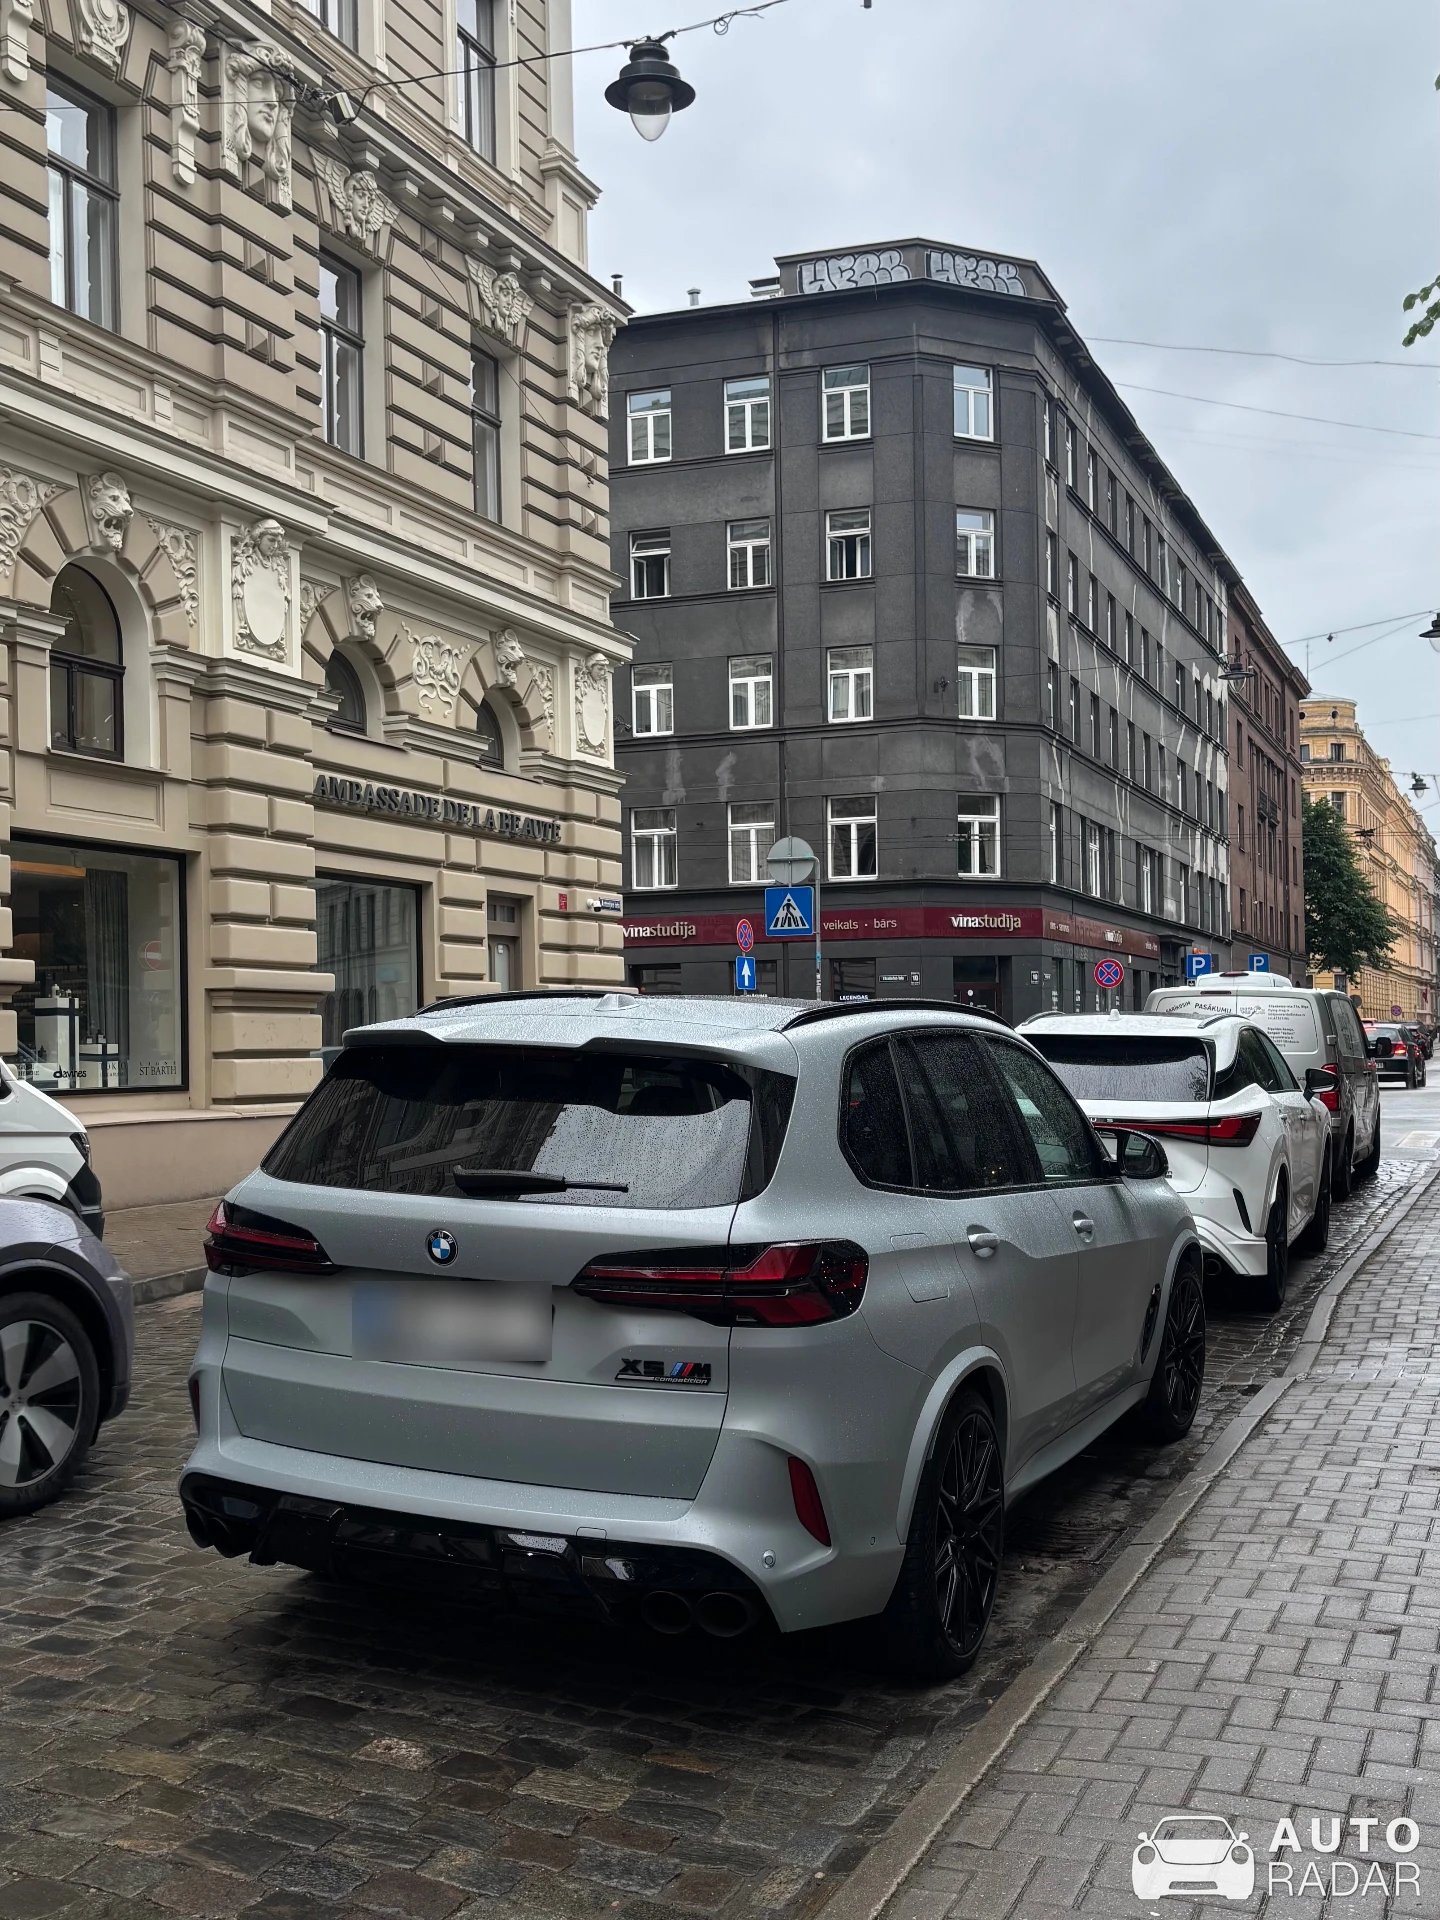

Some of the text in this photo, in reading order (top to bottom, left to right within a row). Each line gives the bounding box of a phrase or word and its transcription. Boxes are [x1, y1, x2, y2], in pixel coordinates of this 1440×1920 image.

[313, 774, 562, 843] AMBASSADE DE LA BEAUTÉ
[623, 921, 697, 940] vīnastudija
[823, 917, 898, 931] veikals bārs
[949, 913, 1022, 932] vīnastudija
[1192, 957, 1206, 976] P
[1253, 956, 1265, 972] P
[52, 1064, 87, 1079] davines
[139, 1066, 177, 1076] ST BARTH
[619, 1358, 665, 1376] X5
[654, 1376, 708, 1385] competition
